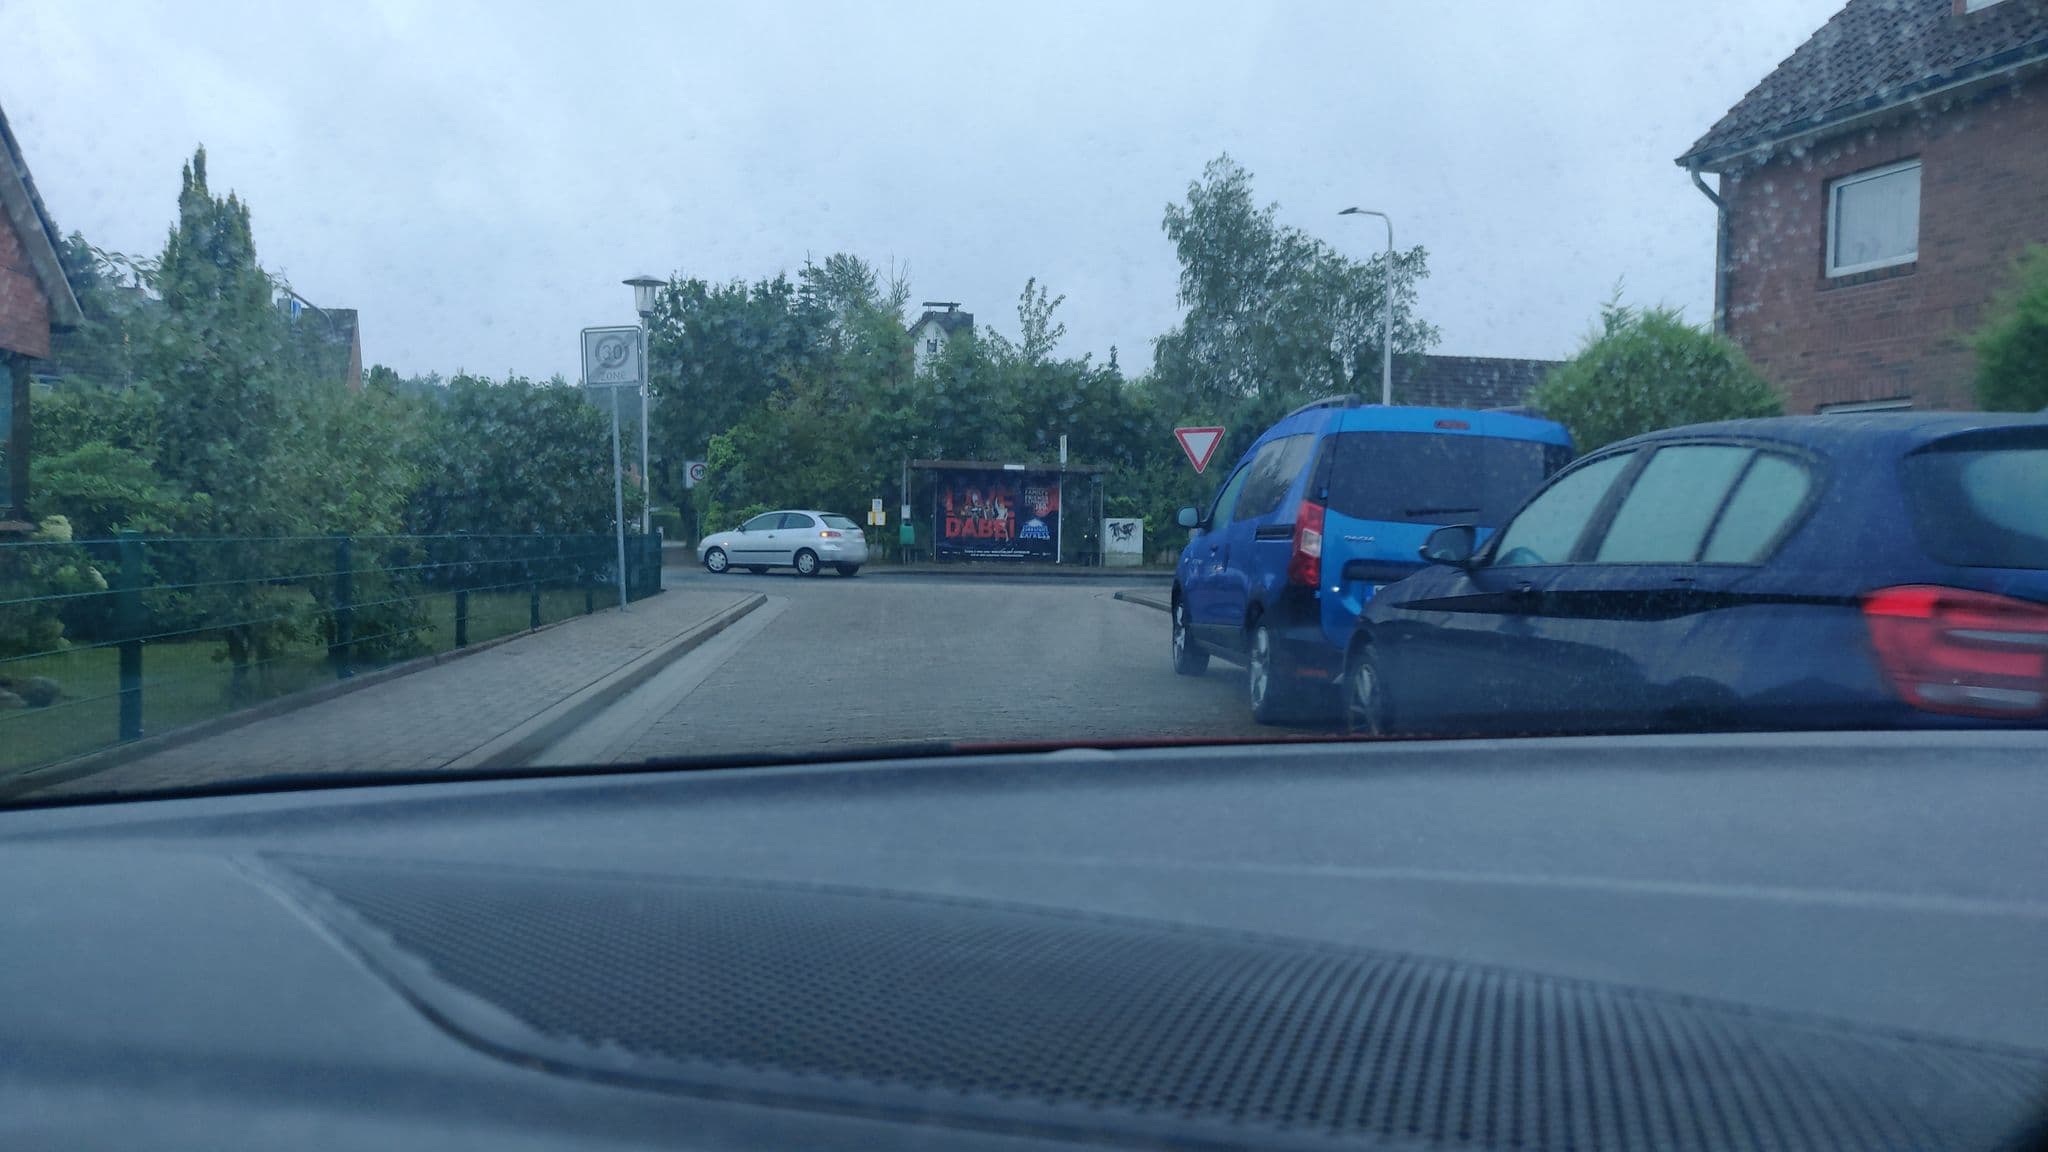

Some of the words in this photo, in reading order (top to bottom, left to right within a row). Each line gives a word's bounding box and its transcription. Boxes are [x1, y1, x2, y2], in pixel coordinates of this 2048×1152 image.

[602, 344, 622, 360] 30
[601, 371, 625, 381] ZONE
[945, 517, 1015, 537] DABEI
